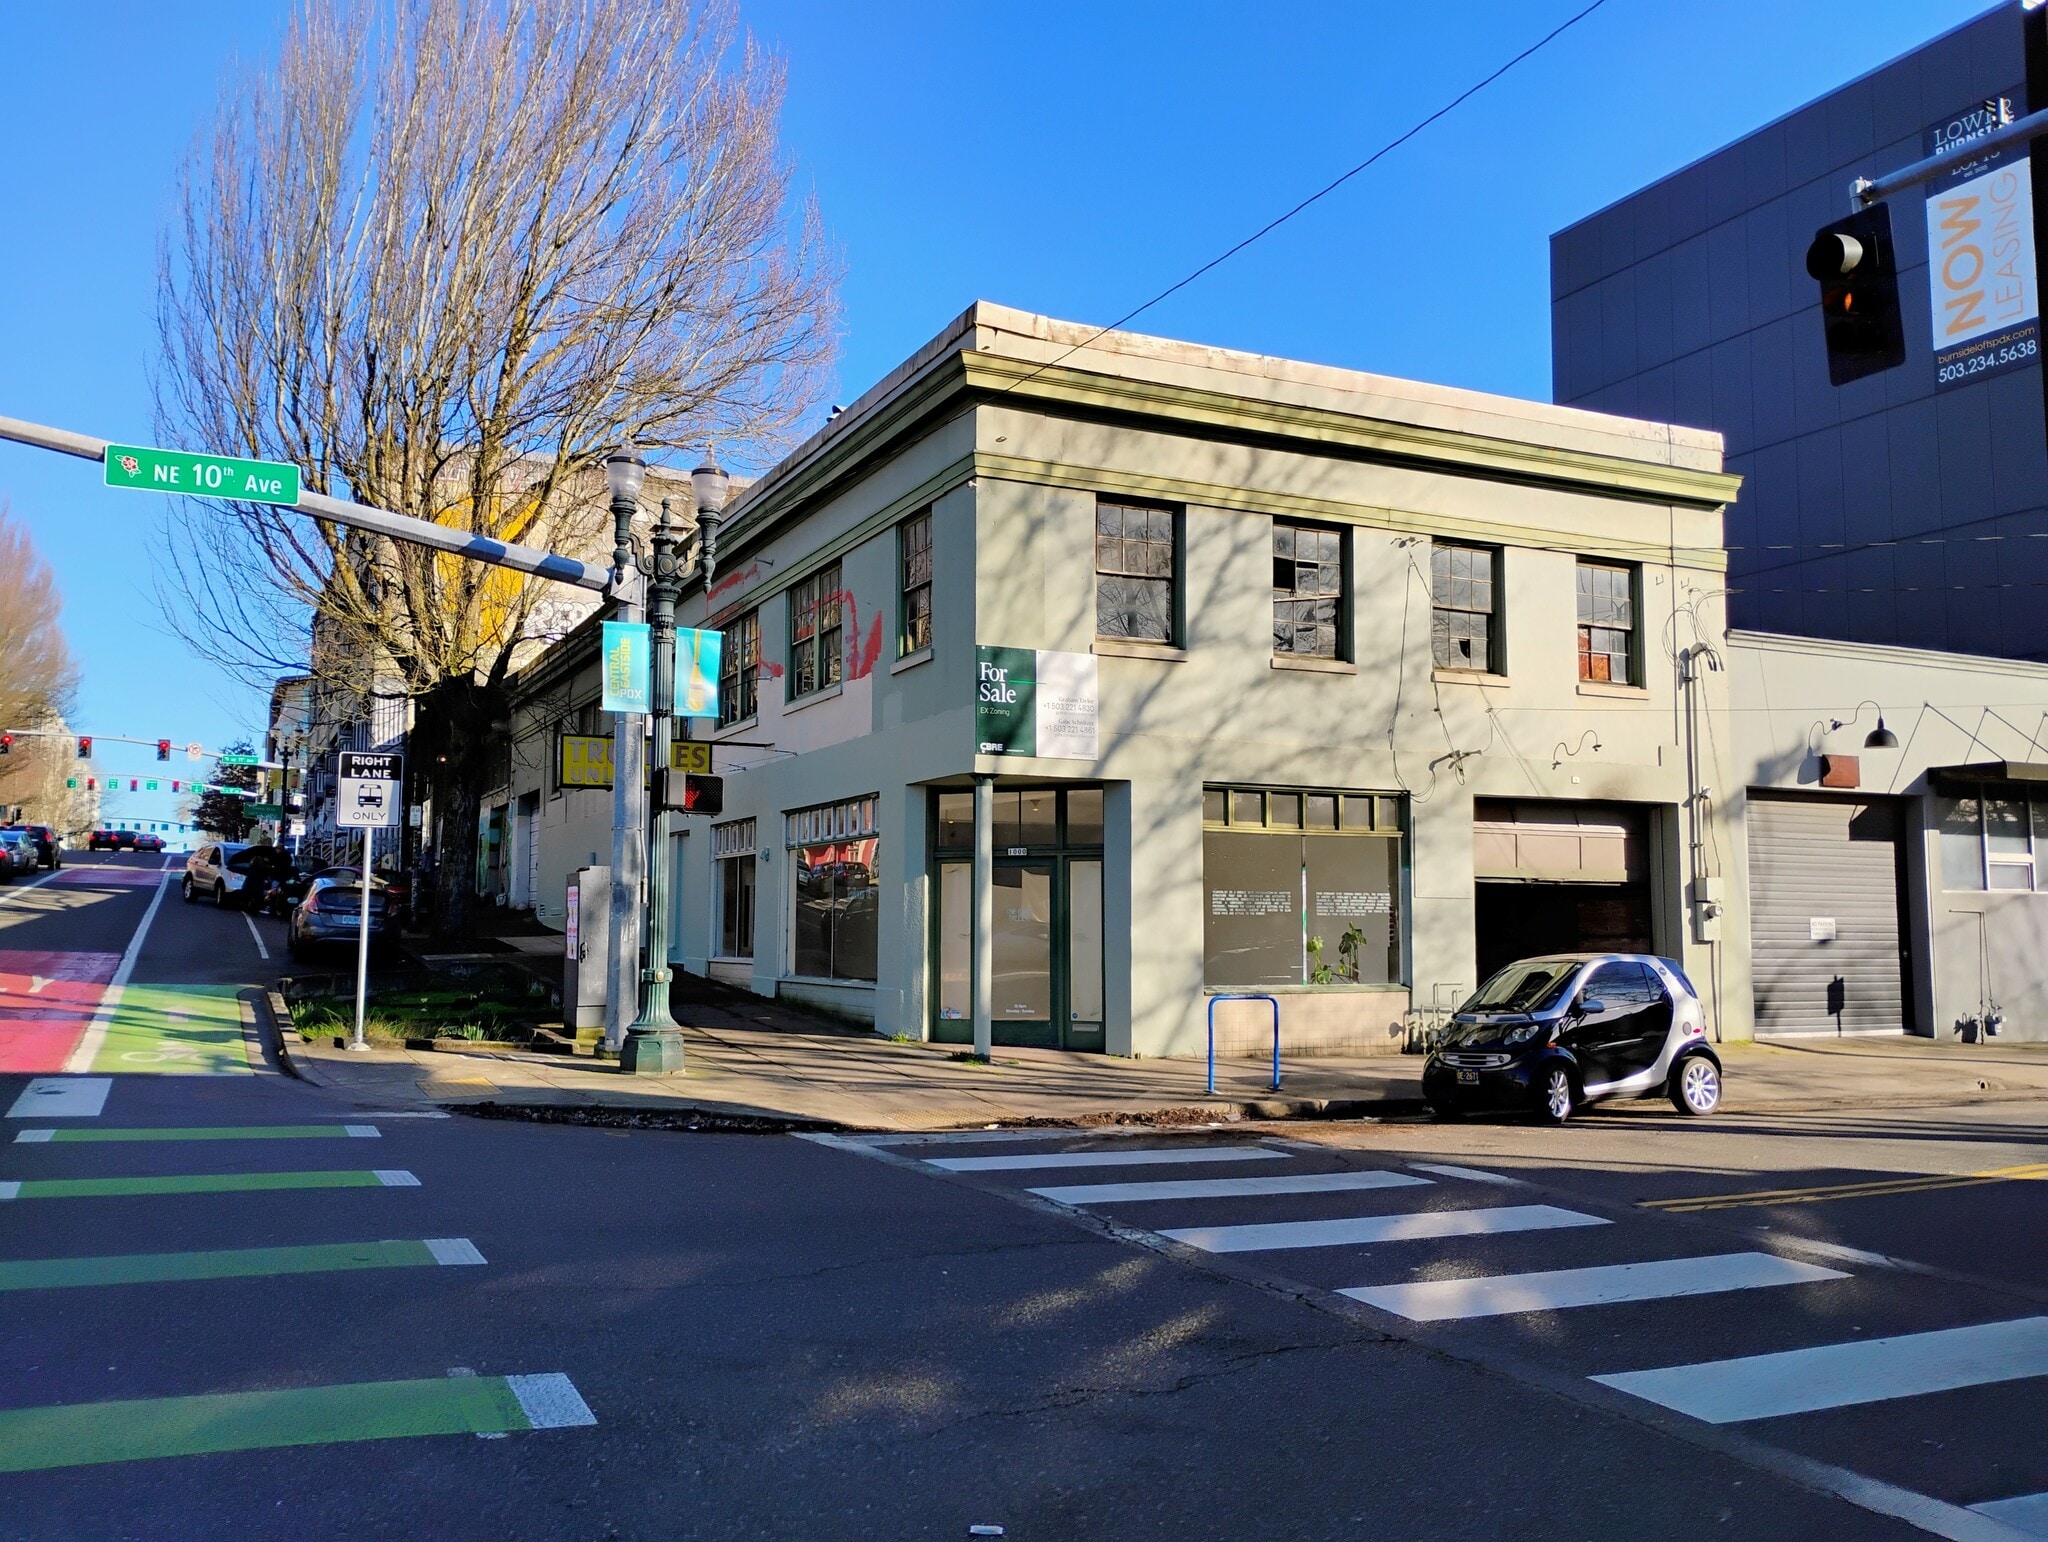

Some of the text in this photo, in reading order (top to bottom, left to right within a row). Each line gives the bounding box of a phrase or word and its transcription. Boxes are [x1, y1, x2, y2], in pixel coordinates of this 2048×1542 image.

[1988, 172, 2024, 321] LEASING
[1939, 195, 1986, 336] NOW
[1938, 325, 2035, 365] burnsideloftspdx.com
[1938, 340, 2037, 384] 503.234.5638
[153, 463, 283, 495] NE 10th Ave
[609, 645, 619, 697] CENTRAL
[620, 636, 630, 688] EASTSIDE
[980, 661, 1008, 682] For
[620, 688, 642, 699] PDX
[980, 682, 1016, 703] Sale
[980, 706, 1010, 717] EX Zoning
[1051, 702, 1064, 711] 503
[980, 742, 1003, 752] CBRE
[351, 755, 392, 767] RIGHT
[350, 767, 392, 779] LANE
[352, 811, 386, 821] ONLY
